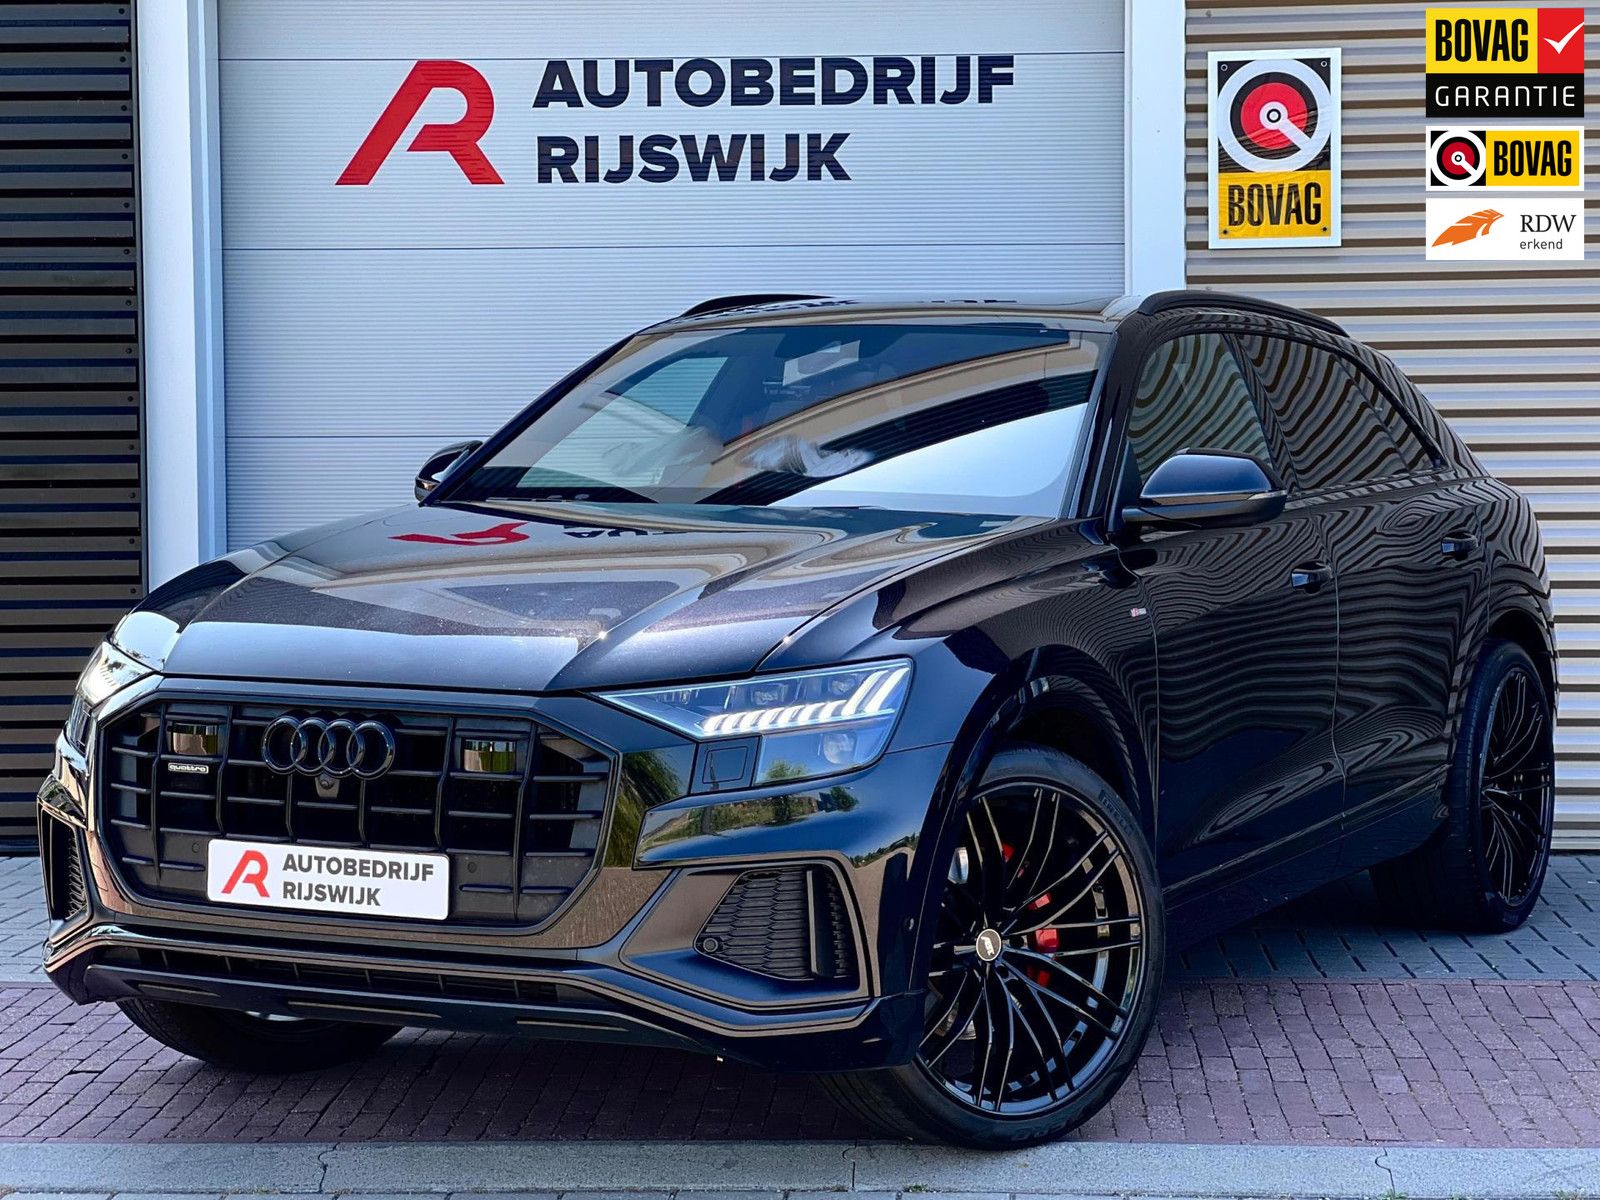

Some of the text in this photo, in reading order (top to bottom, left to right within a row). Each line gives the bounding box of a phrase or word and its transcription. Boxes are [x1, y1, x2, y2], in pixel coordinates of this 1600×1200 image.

[533, 55, 1014, 108] AUTOBEDRIJF
[537, 133, 851, 184] RIJSWIJK
[1228, 181, 1322, 227] BOVAG
[169, 764, 207, 772] quattro
[282, 853, 434, 882] AUTOBEDRIJF
[282, 881, 381, 907] RIJSWIJK
